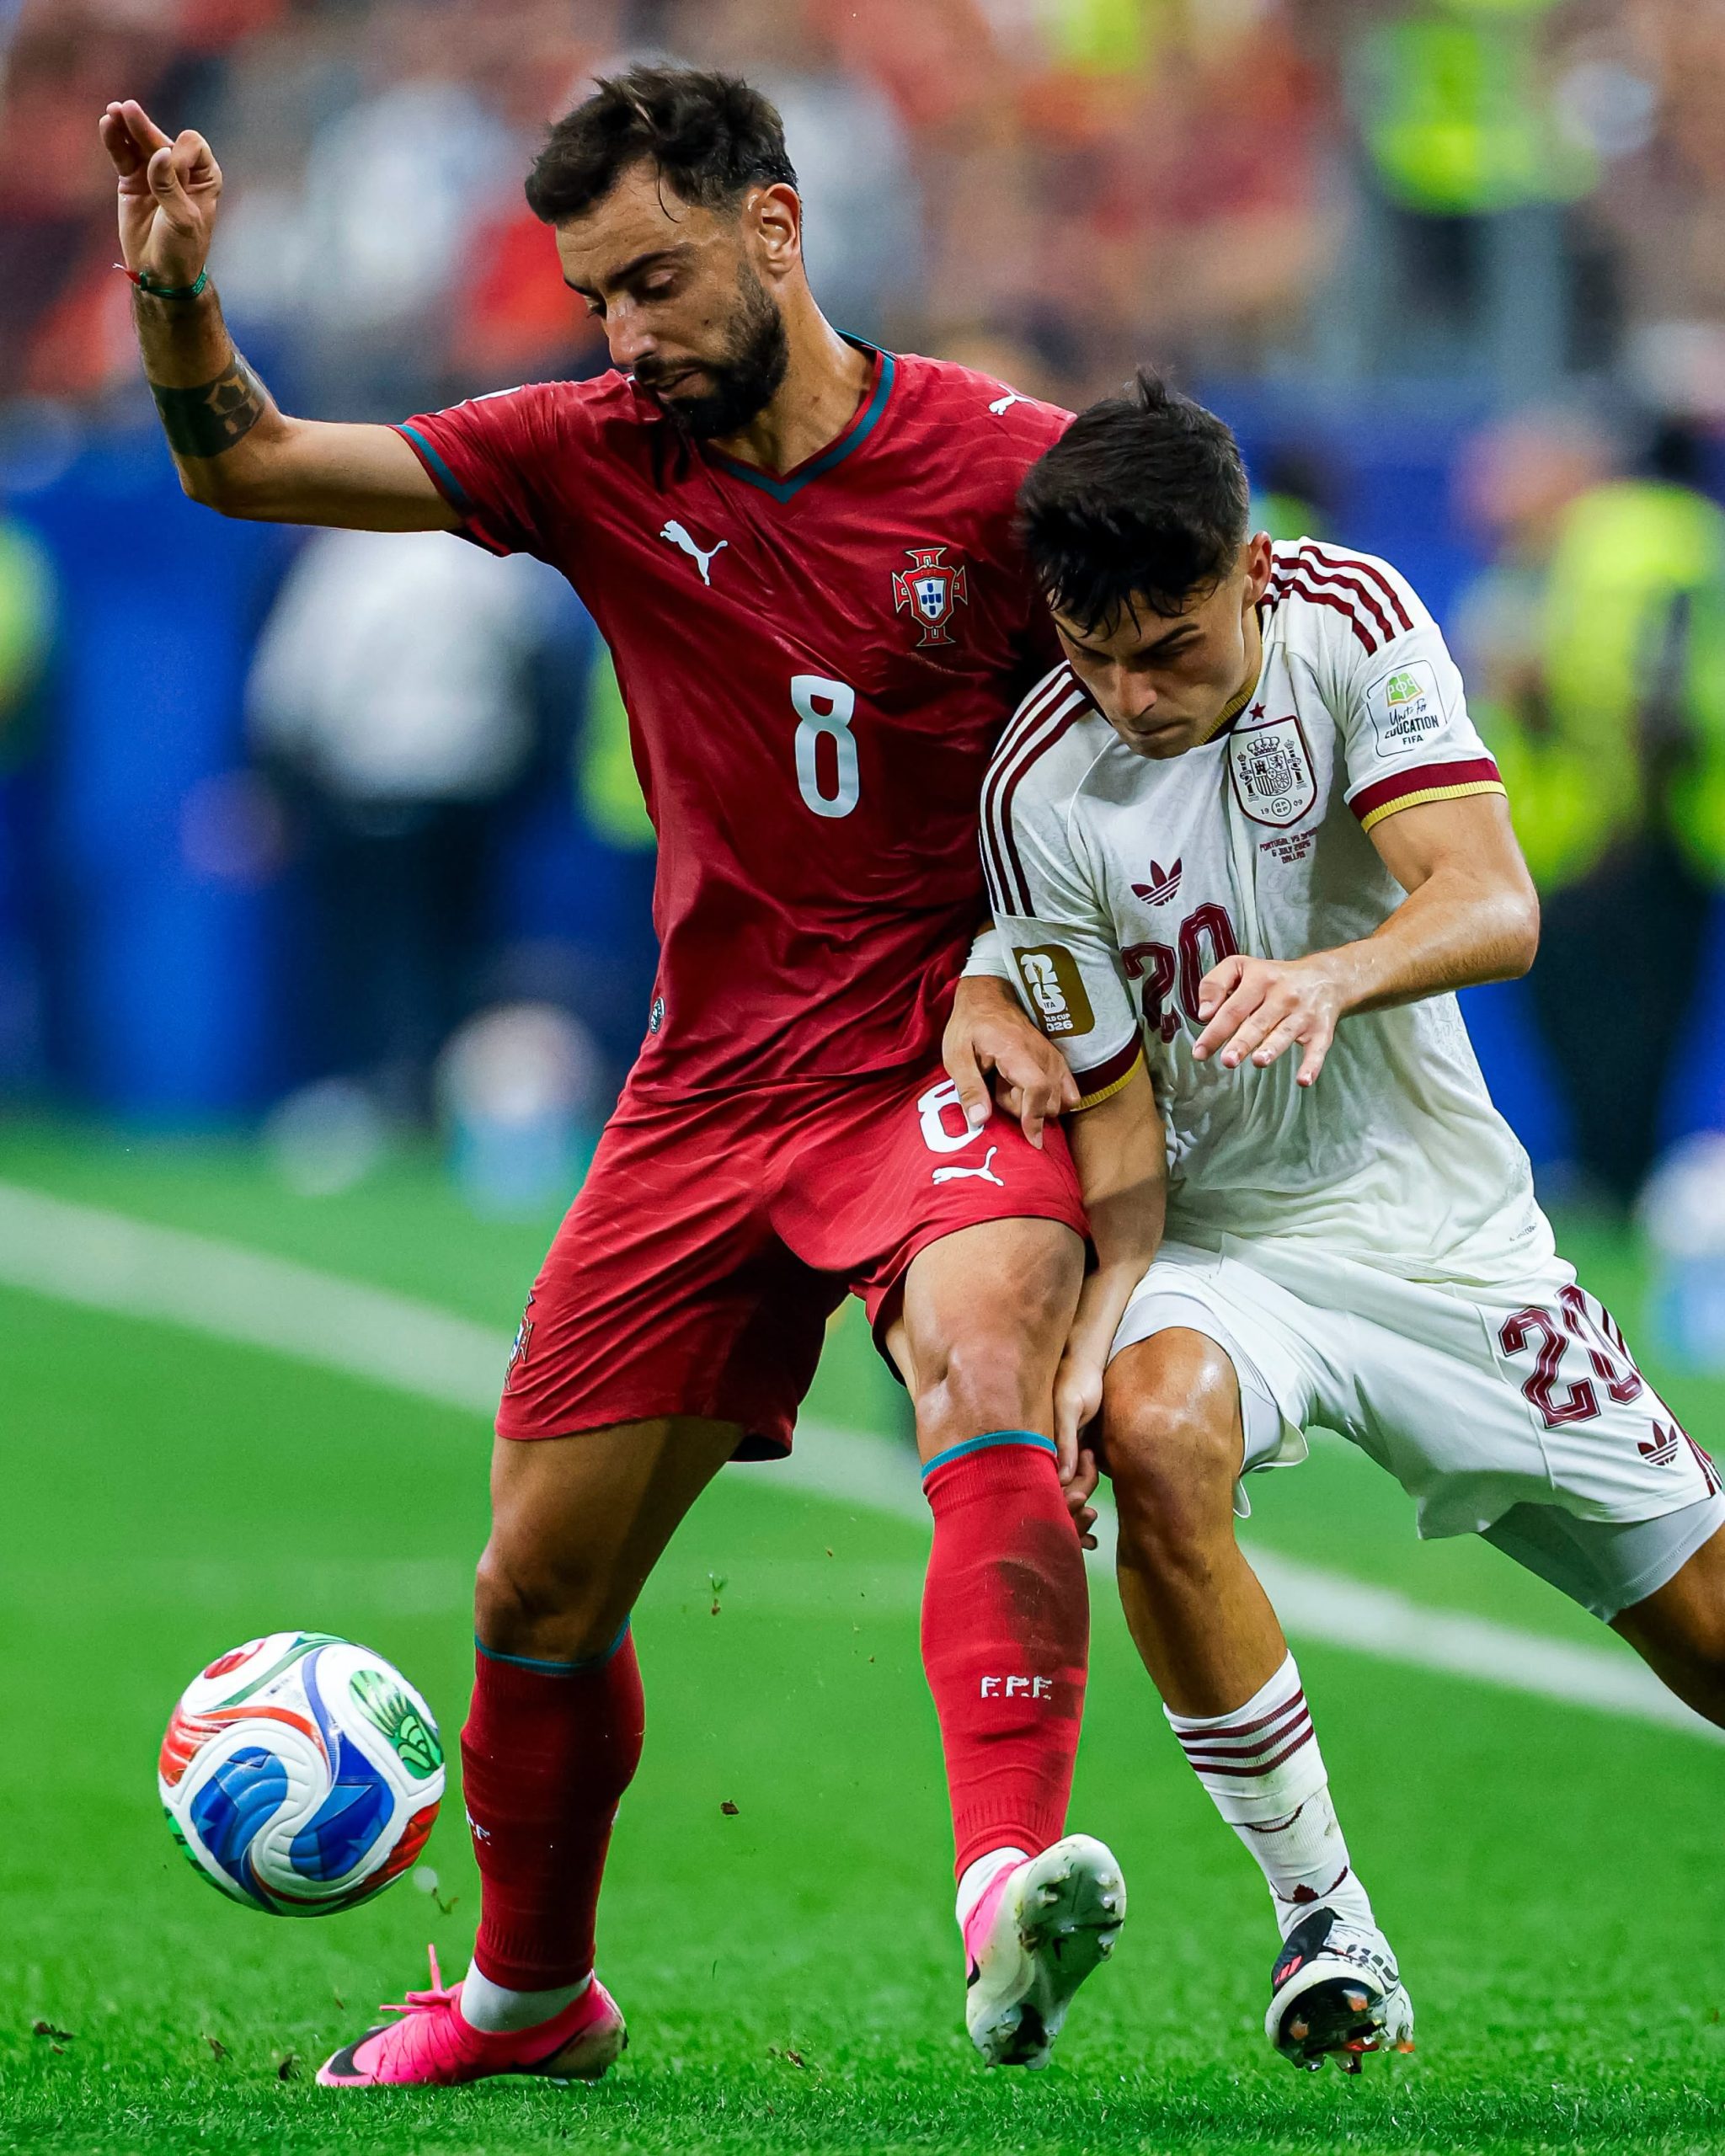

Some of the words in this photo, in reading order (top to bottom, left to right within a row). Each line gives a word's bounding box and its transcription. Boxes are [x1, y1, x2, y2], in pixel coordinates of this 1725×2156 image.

[791, 675, 859, 818] 8
[1384, 715, 1439, 739] EDUCATION
[1402, 734, 1423, 744] FIFA
[1121, 902, 1239, 1043] 20
[1046, 1020, 1074, 1033] 026
[1498, 1283, 1644, 1430] 20
